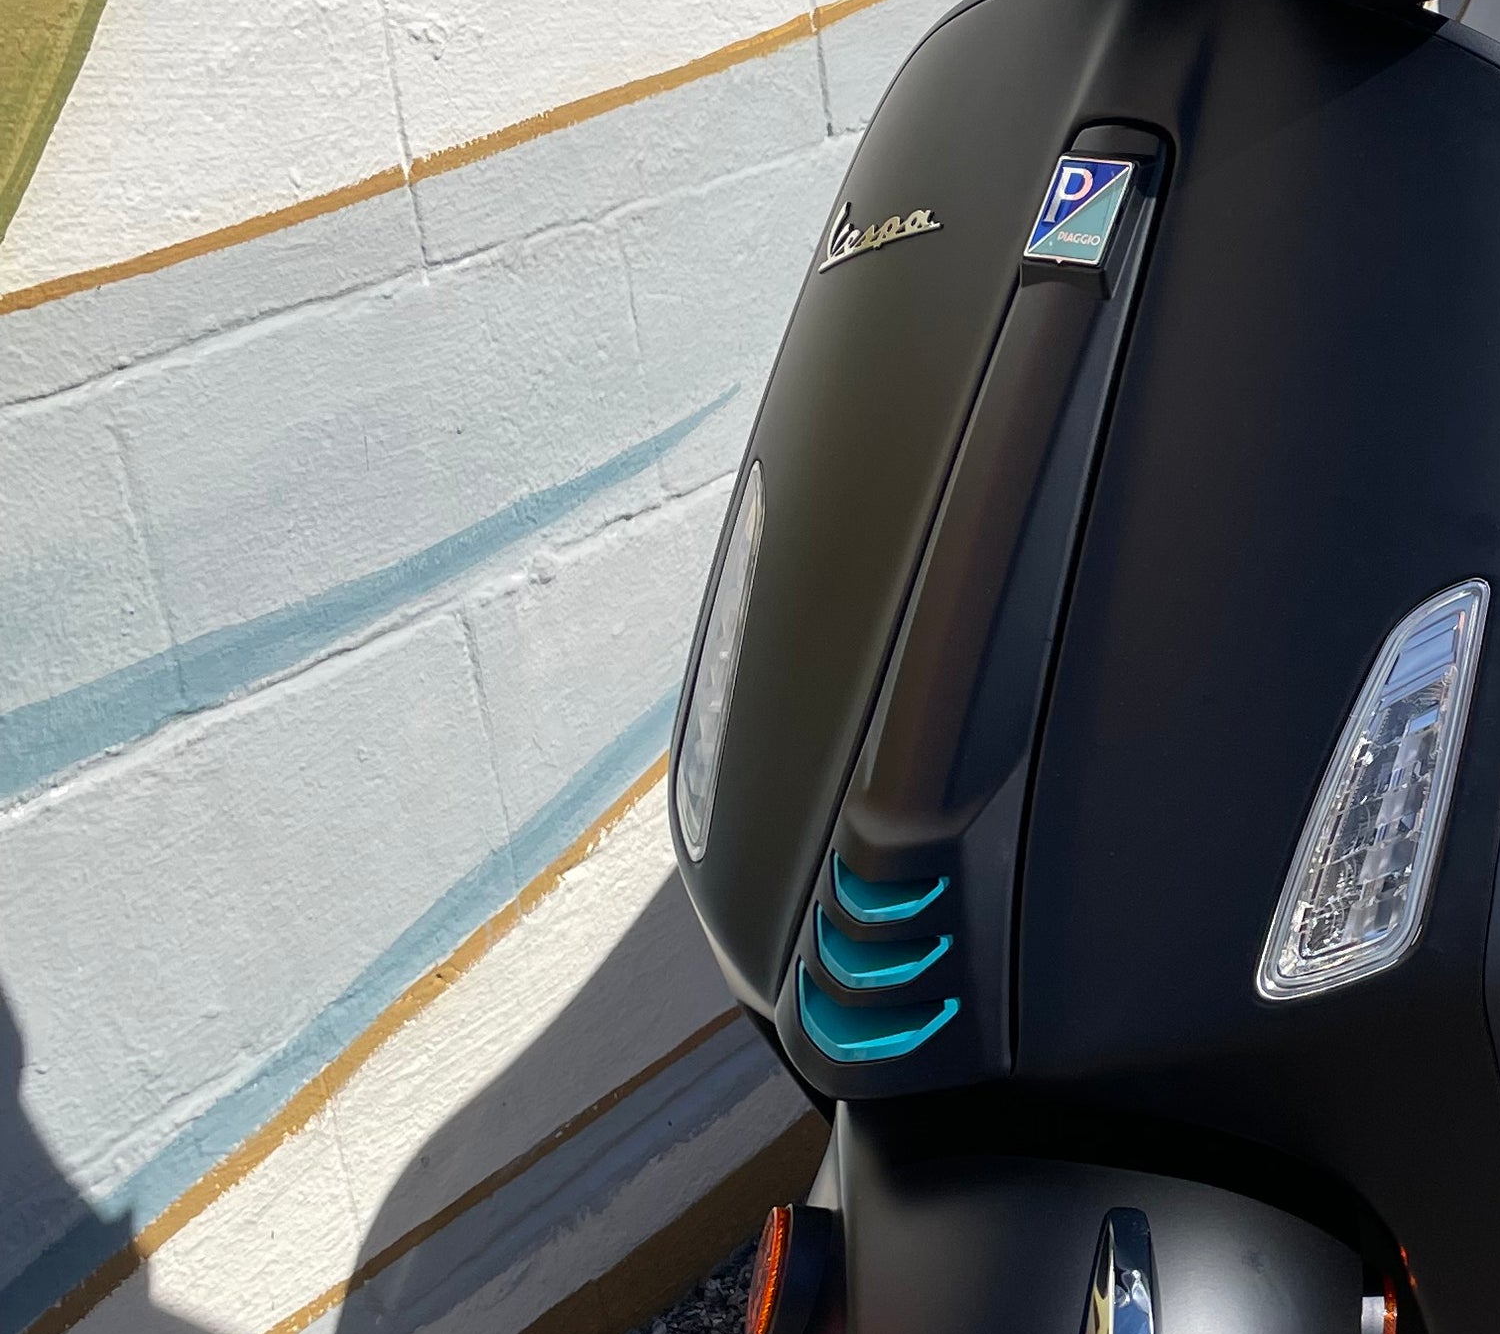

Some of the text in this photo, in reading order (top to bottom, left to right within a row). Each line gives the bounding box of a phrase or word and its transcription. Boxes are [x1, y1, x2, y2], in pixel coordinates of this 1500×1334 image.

[1043, 166, 1094, 224] P
[817, 200, 945, 274] Vespa
[1056, 230, 1102, 247] PIAGGIO
